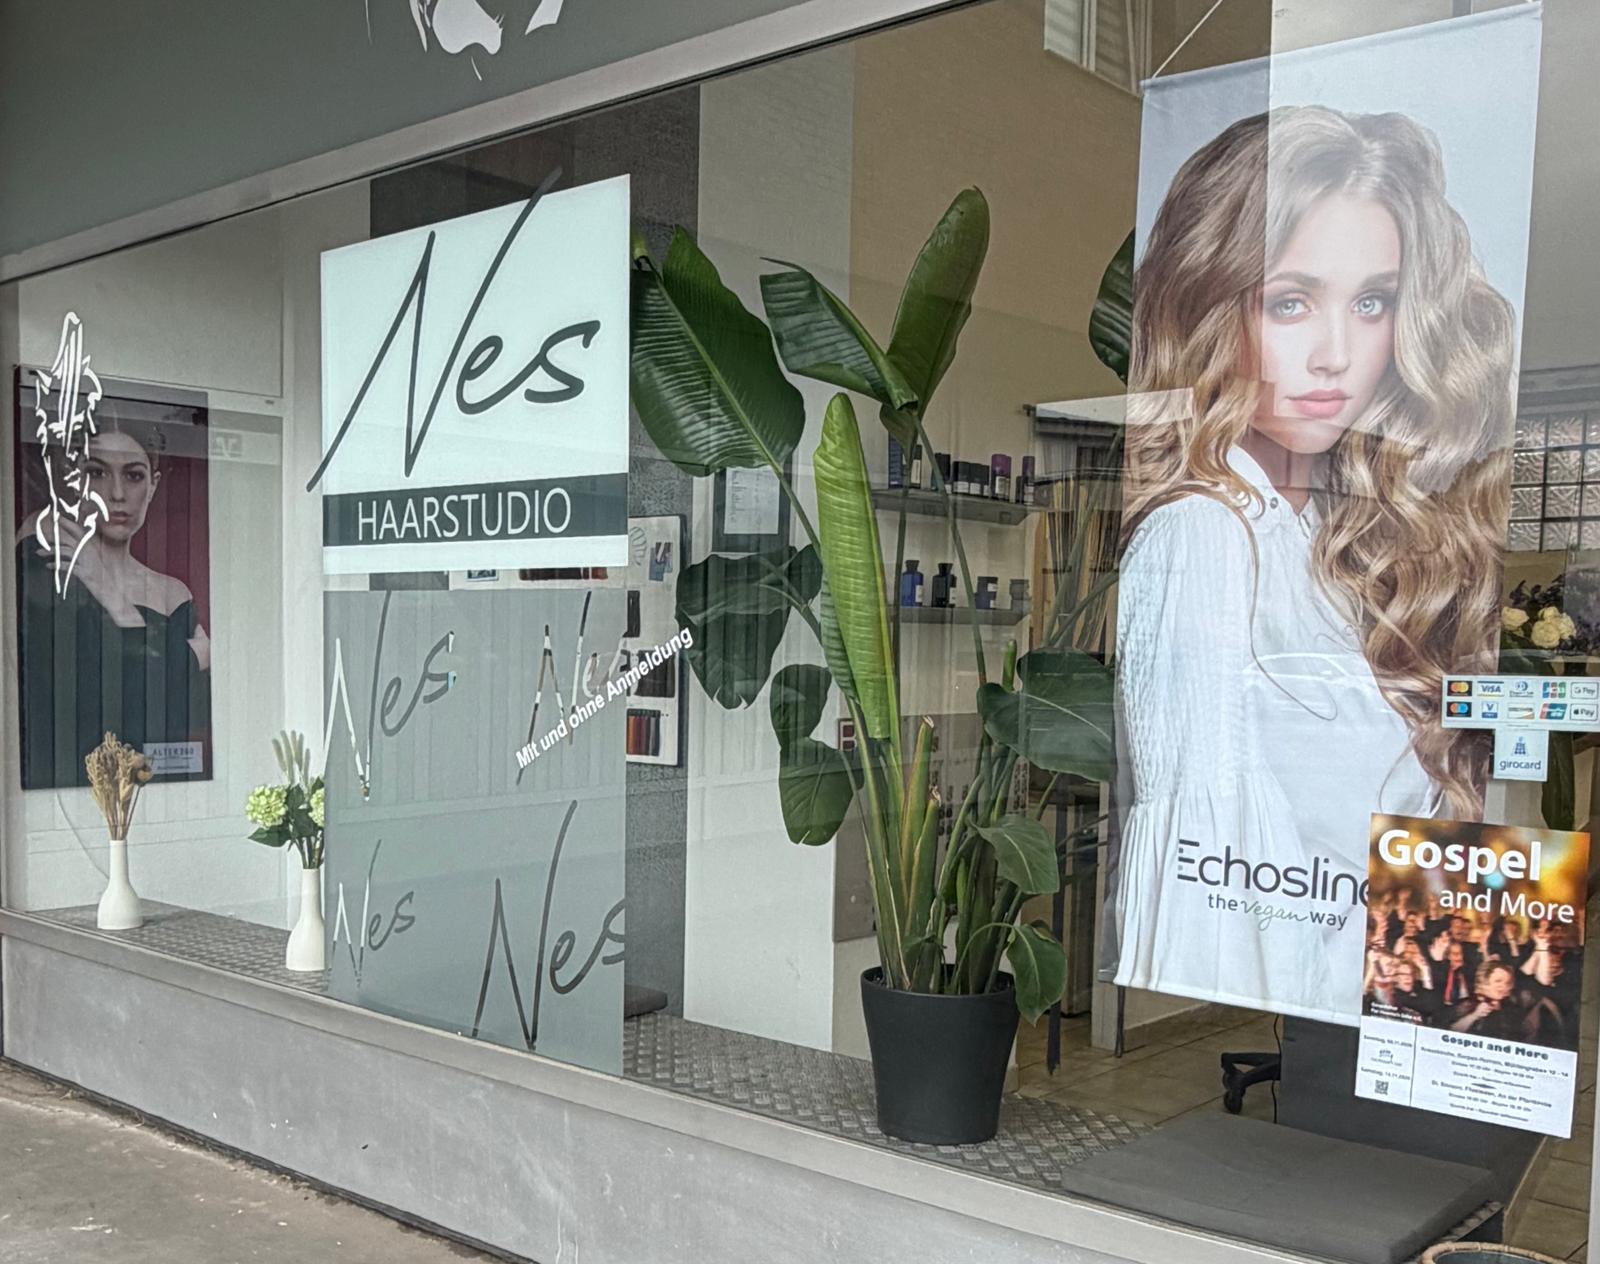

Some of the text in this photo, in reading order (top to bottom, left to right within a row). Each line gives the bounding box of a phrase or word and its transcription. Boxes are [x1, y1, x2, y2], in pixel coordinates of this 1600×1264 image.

[306, 167, 601, 492] Nes
[357, 487, 572, 541] HAARSTUDIO
[323, 588, 457, 802] Nes
[515, 627, 694, 769] Mit und ohne Anmeldung
[1481, 685, 1502, 693] VISA
[1499, 760, 1541, 771] girocard
[1378, 829, 1541, 884] Gospel
[326, 839, 416, 989] Nes
[472, 800, 626, 1051] Nes
[1208, 893, 1238, 911] the
[1310, 911, 1348, 931] way
[1440, 888, 1574, 924] and More
[1441, 1034, 1483, 1049] Gospel
[1486, 1042, 1511, 1054] and
[1515, 1046, 1549, 1060] More
